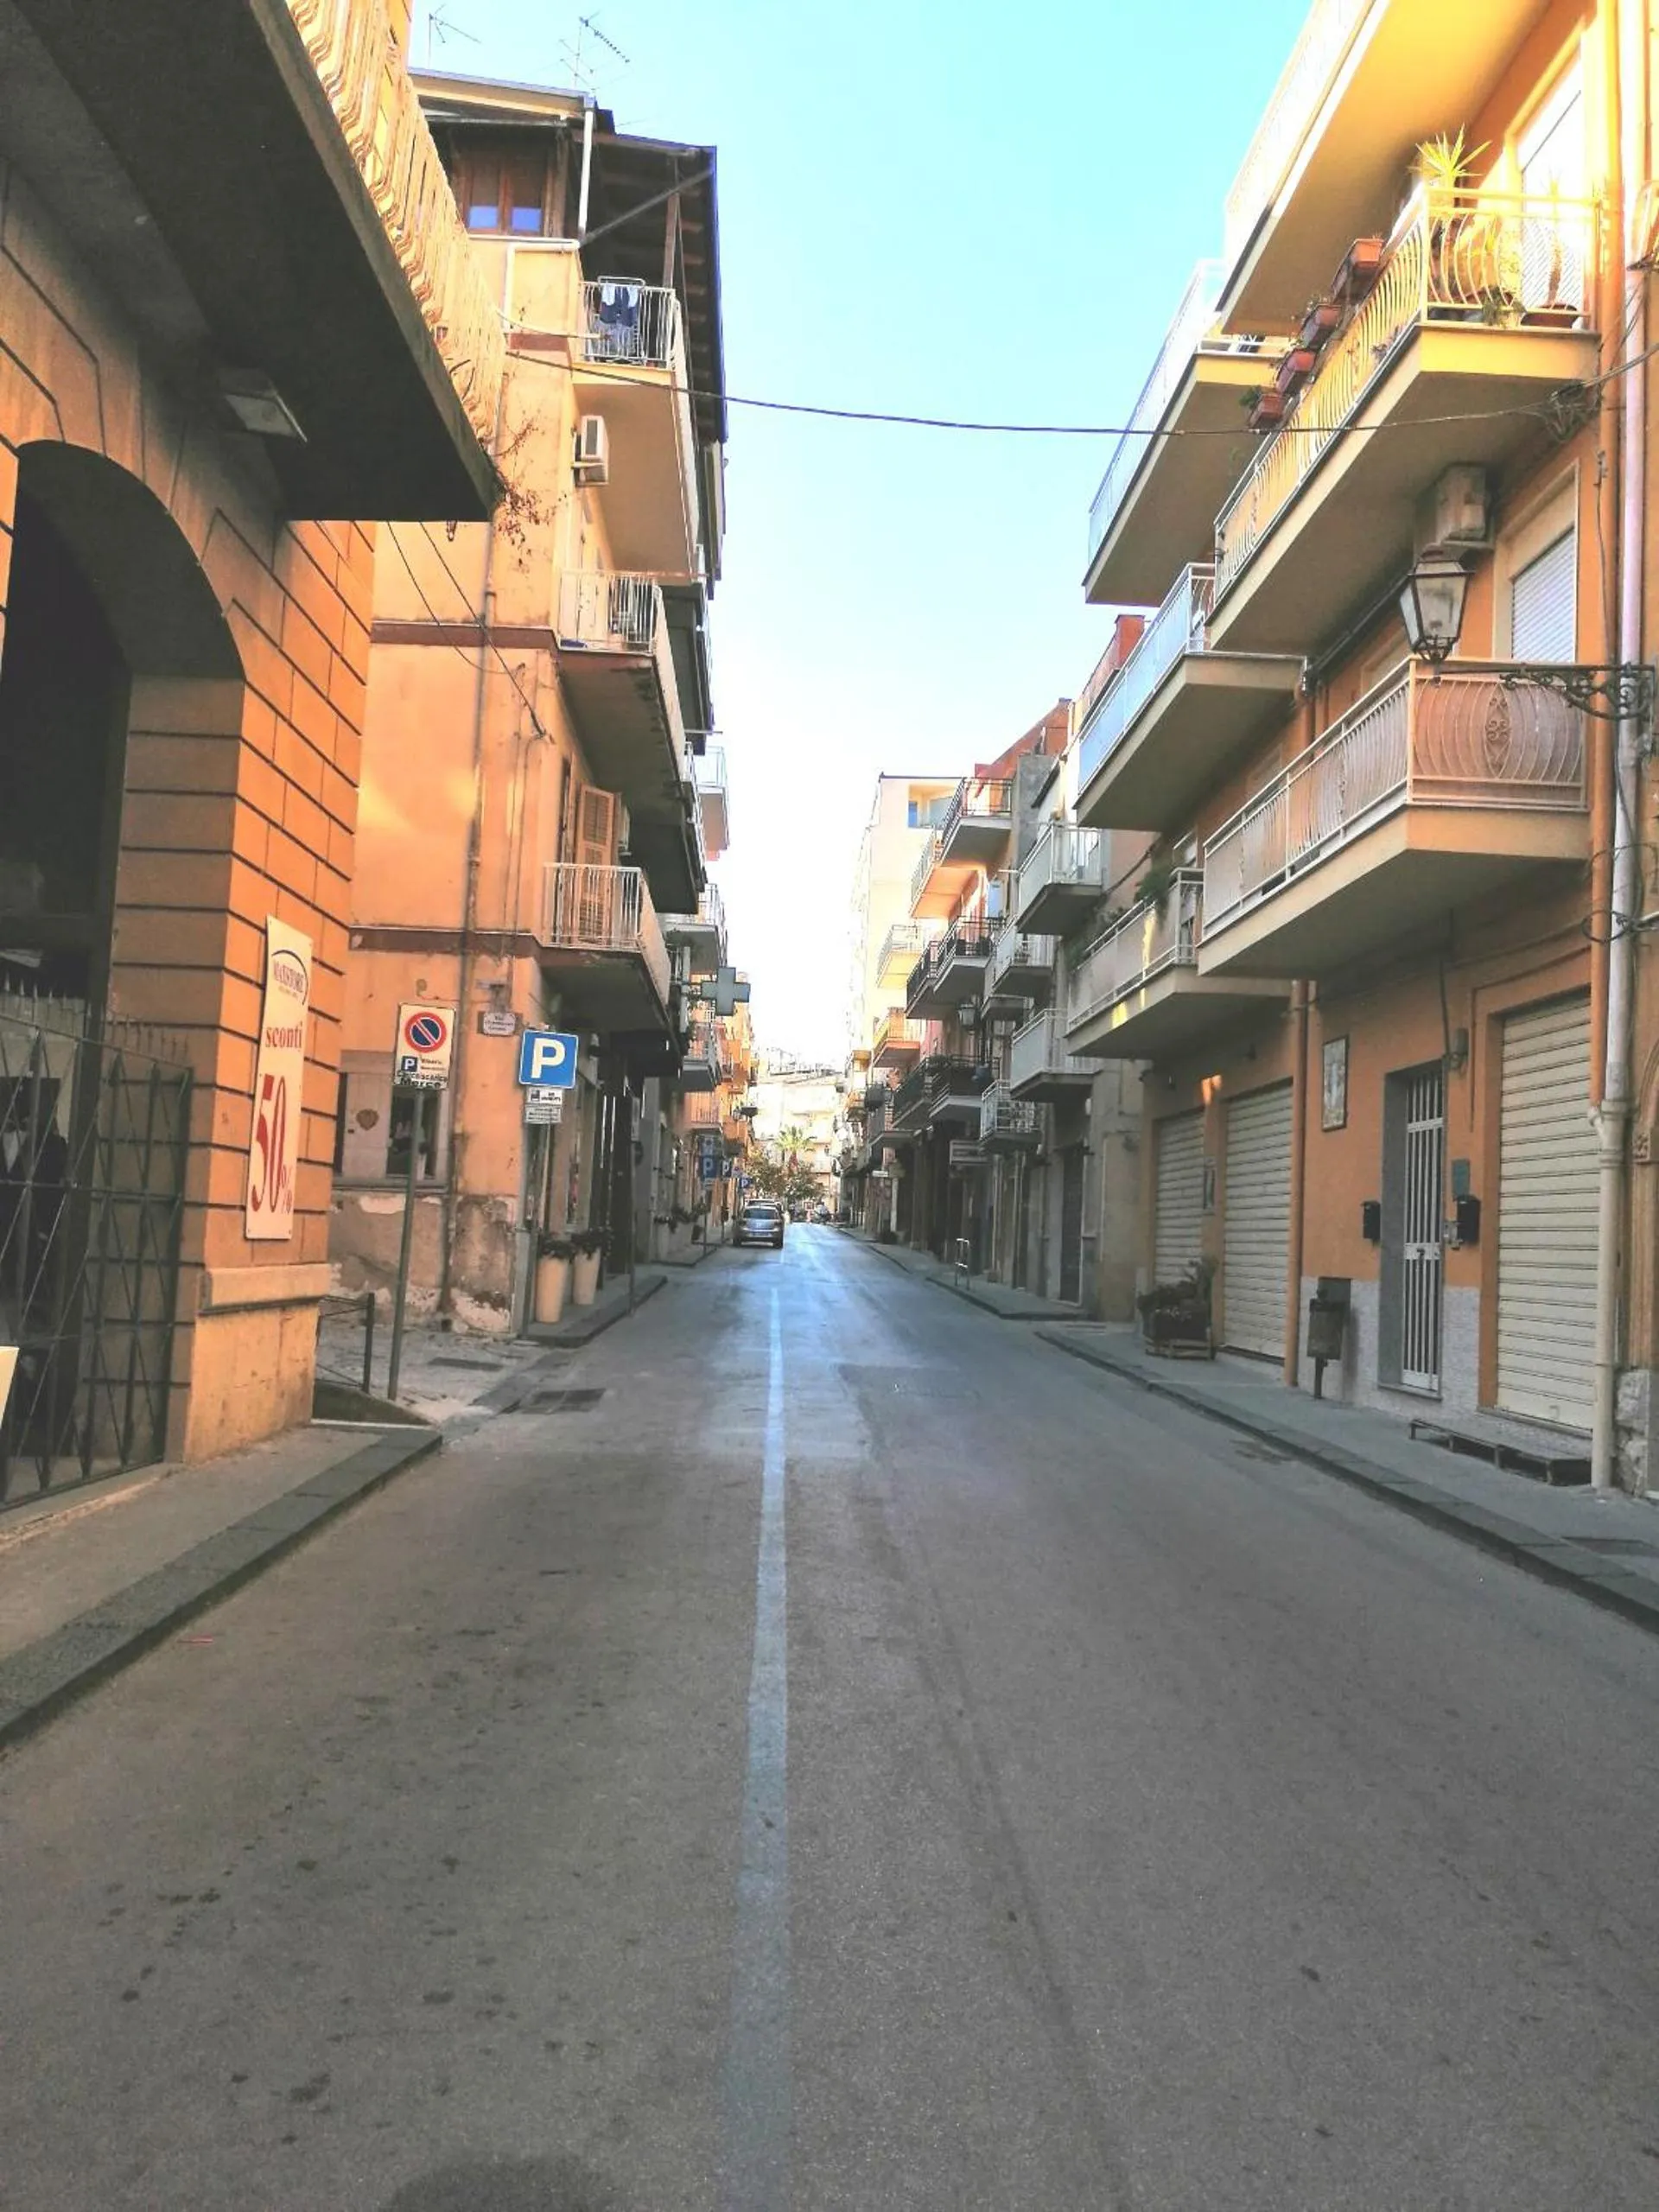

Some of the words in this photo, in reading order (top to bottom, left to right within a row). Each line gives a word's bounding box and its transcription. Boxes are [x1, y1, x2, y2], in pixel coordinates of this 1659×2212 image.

[265, 1020, 302, 1048] sconti
[405, 1058, 415, 1070] P
[531, 1038, 565, 1078] P
[703, 1157, 714, 1176] P
[722, 1160, 730, 1176] P
